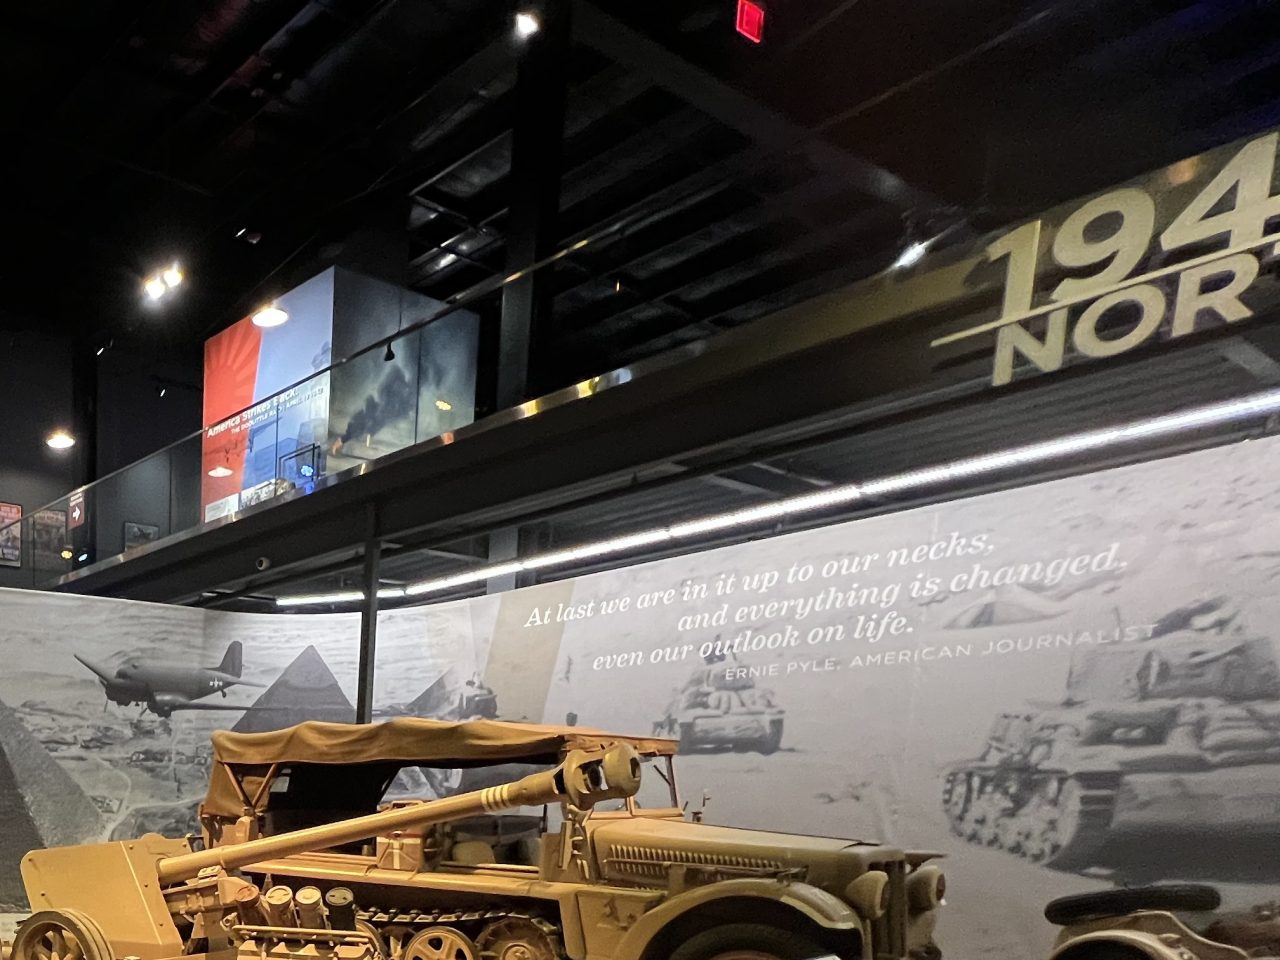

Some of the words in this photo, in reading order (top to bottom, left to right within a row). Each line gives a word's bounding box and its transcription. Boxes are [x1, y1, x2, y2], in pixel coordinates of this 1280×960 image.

[991, 252, 1280, 387] NOR
[523, 604, 550, 628] At
[555, 597, 595, 622] last
[599, 593, 630, 614] we
[635, 588, 675, 609] are
[683, 579, 708, 601] in
[715, 572, 735, 596] it
[742, 567, 780, 594] up
[786, 559, 814, 584] to
[821, 550, 880, 579] our
[886, 530, 996, 568] necks,
[677, 603, 729, 632] and
[734, 579, 902, 621] everything
[910, 571, 943, 599] is
[948, 542, 1130, 589] changed,
[592, 650, 645, 671] even
[649, 642, 694, 664] our
[699, 625, 801, 660] outlook
[807, 625, 847, 645] on
[853, 608, 915, 644] life.
[724, 663, 782, 682] ERNIE
[785, 656, 842, 677] PYLE,
[849, 645, 972, 670] AMERICAN
[980, 621, 1161, 657] JOURNALIST
